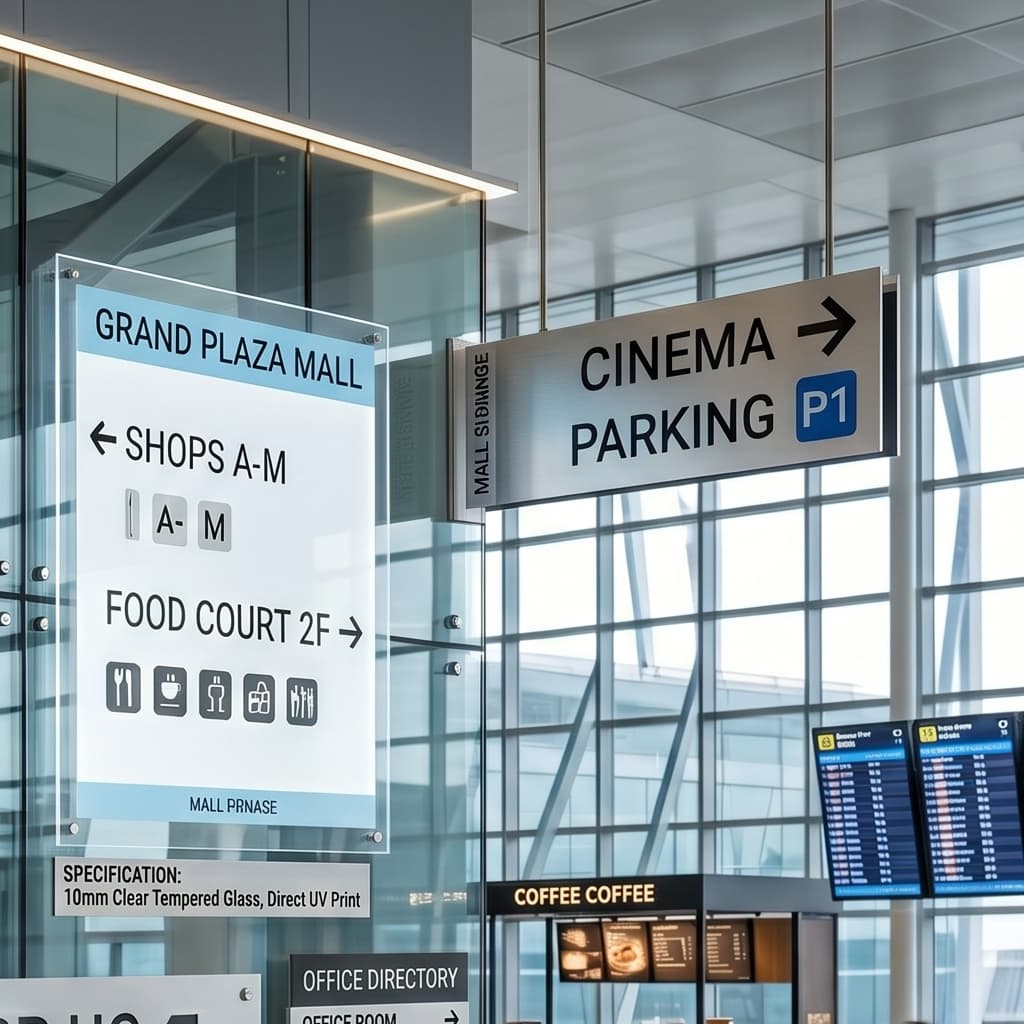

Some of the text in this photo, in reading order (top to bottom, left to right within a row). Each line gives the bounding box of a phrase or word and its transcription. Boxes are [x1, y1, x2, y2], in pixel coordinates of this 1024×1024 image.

[96, 308, 362, 389] GRAND PLAZA MALL
[581, 318, 775, 391] CINEMA
[572, 394, 773, 466] PARKING
[804, 387, 845, 427] P1
[126, 426, 285, 484] SHOPS A-M
[474, 441, 489, 494] MALL
[107, 590, 330, 646] FOOD COURT 2F
[190, 797, 224, 812] MALL
[64, 865, 181, 883] SPECIFICATION:
[515, 884, 654, 905] COFFEE COFFEE
[65, 888, 360, 910] 10mm Clear Tempered Glass, Direct UV Print
[304, 968, 458, 991] OFFICE DIRECTORY
